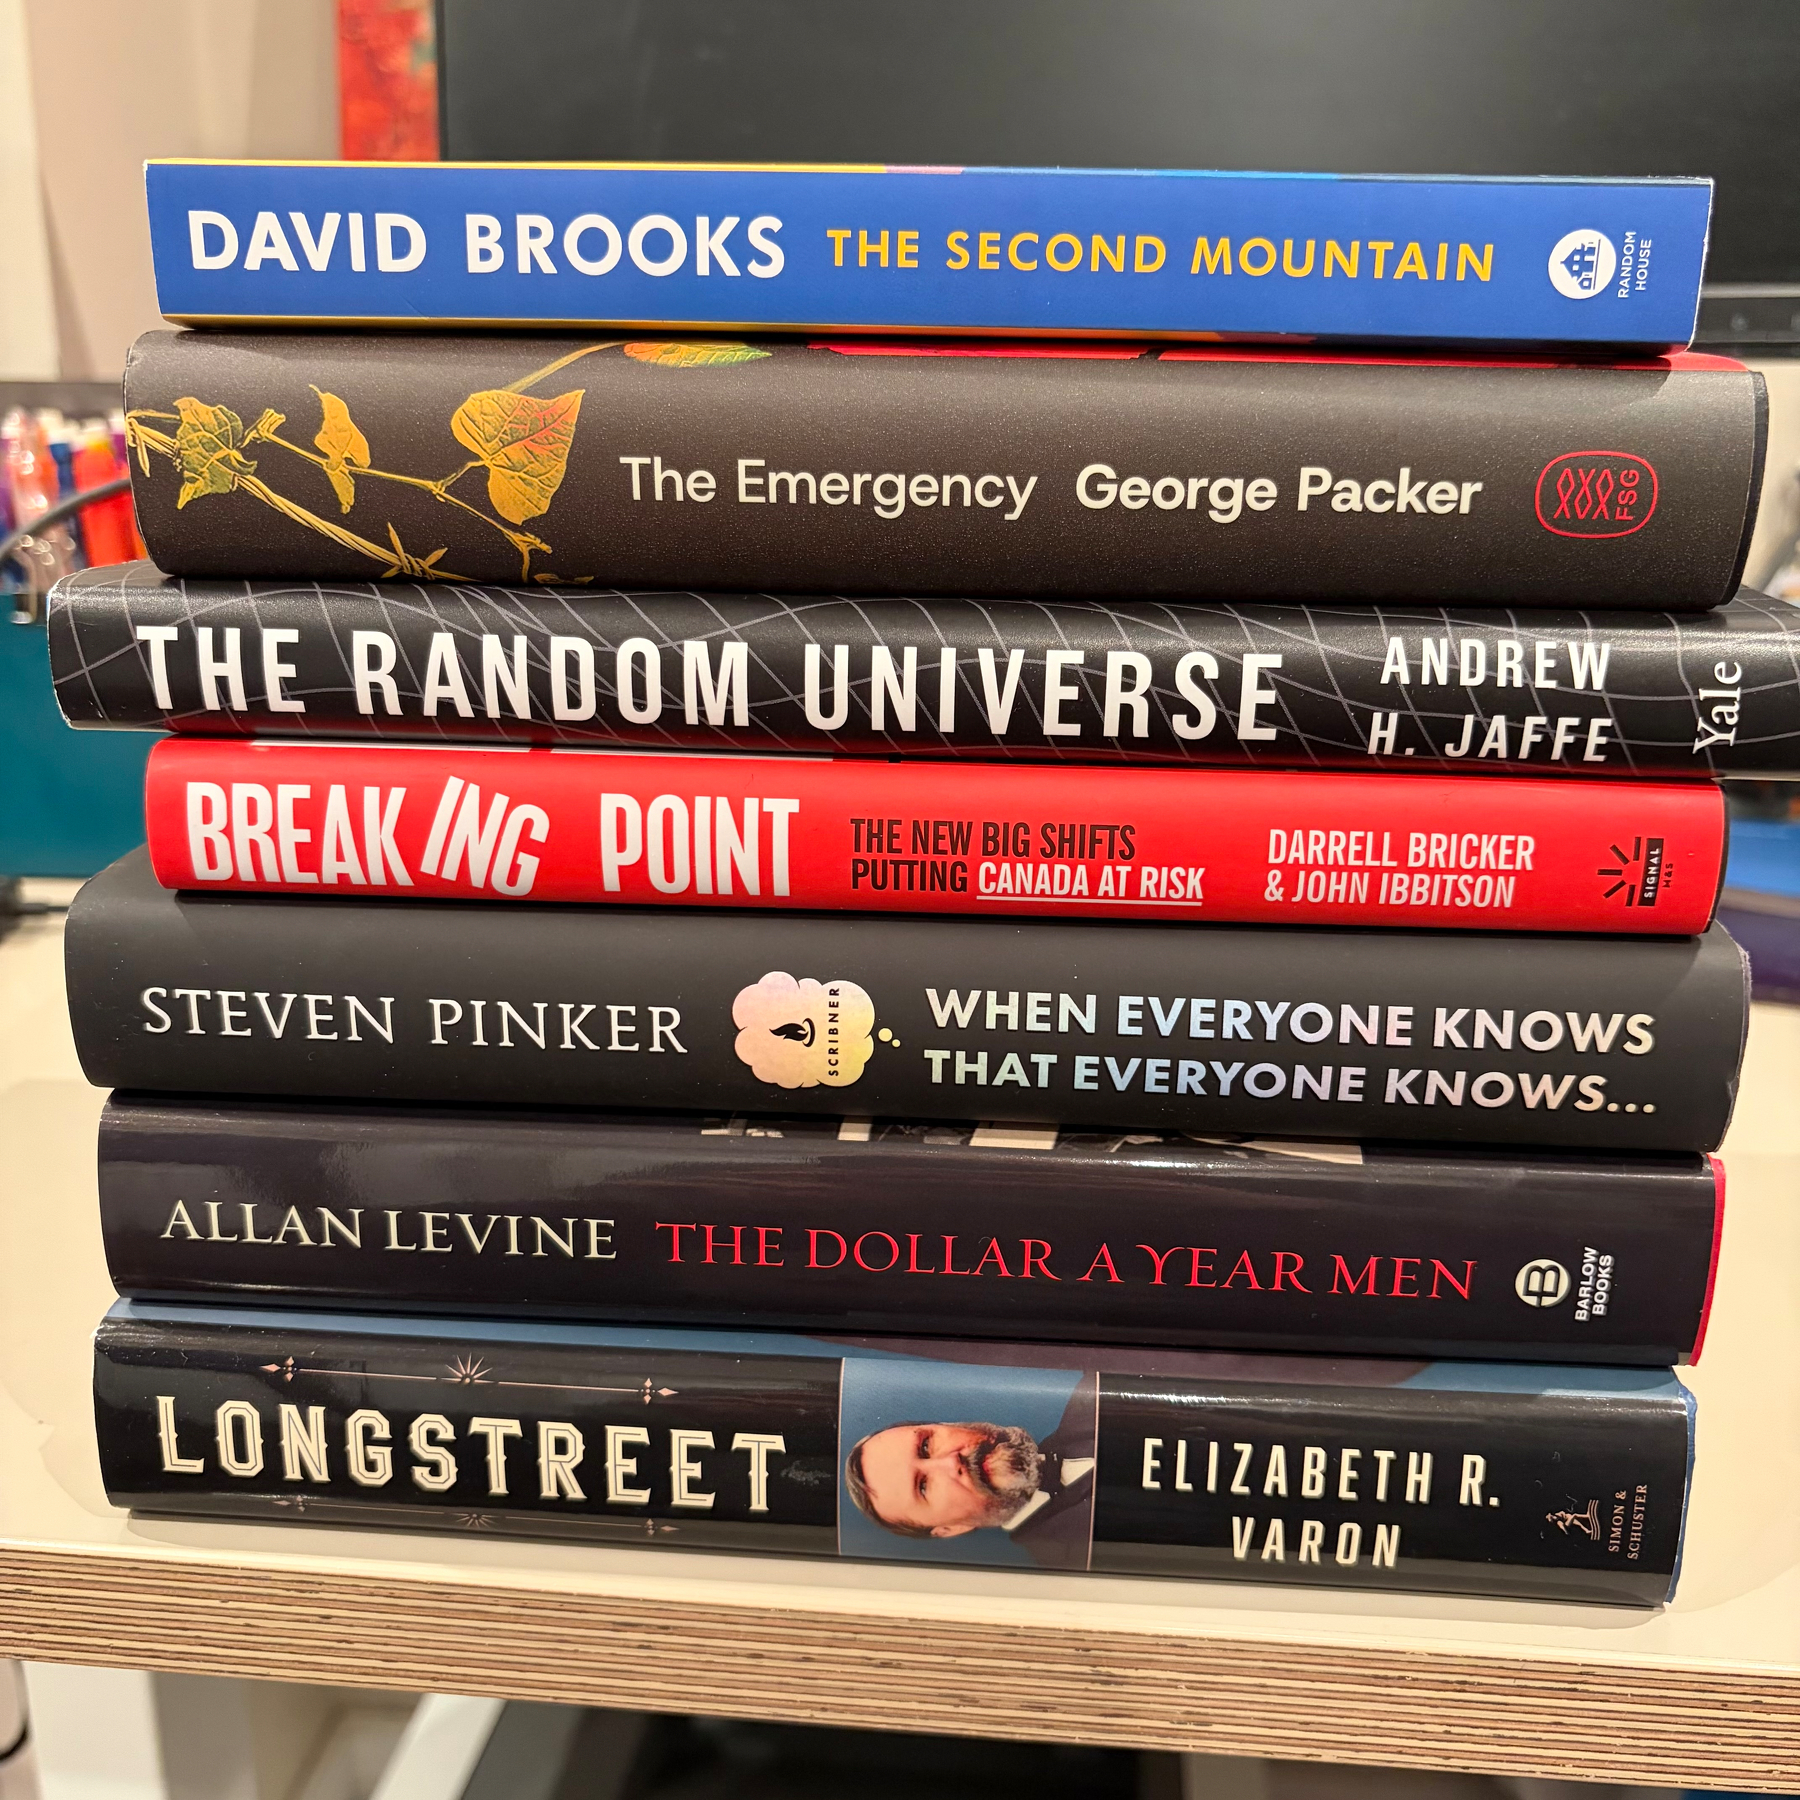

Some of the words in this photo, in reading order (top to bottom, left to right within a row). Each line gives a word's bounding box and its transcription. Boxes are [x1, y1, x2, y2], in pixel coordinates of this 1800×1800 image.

[189, 211, 427, 272] DAVID
[466, 213, 786, 278] BROOKS
[827, 229, 919, 268] THE
[946, 231, 1167, 273] SECOND
[1191, 236, 1494, 282] MOUNTAIN
[1617, 230, 1637, 298] RANDOM
[1634, 239, 1652, 291] HOUSE
[619, 456, 717, 503] The
[737, 458, 1038, 521] Emergency
[1075, 463, 1277, 524] George
[1297, 465, 1483, 515] Packer
[1615, 469, 1640, 521] FSG
[136, 625, 306, 713] THE
[353, 630, 750, 727] RANDOM
[804, 644, 1283, 741] UNIVERSE
[1381, 637, 1612, 692] ANDREW
[1367, 711, 1416, 756] H.
[1445, 713, 1613, 763] JAFFE
[1693, 660, 1743, 755] Yale
[600, 793, 800, 898] POINT
[850, 818, 902, 853] THE
[911, 820, 973, 856] NEW
[981, 822, 1030, 858] BIG
[1039, 824, 1136, 861] SHIFTS
[1268, 829, 1400, 870] DARRELL
[1406, 834, 1535, 872] BRICKER
[851, 859, 968, 892] PUTTING
[977, 861, 1089, 896] CANADA
[1097, 865, 1132, 897] AT
[1138, 866, 1206, 899] RISK
[1264, 869, 1286, 904] &
[1292, 872, 1369, 906] JOHN
[1376, 875, 1516, 909] IBBITSON
[1643, 848, 1661, 898] SIGNAL
[142, 987, 397, 1045] STEVEN
[429, 997, 689, 1055] PINKER
[828, 988, 840, 1076] SCRIBNER
[925, 988, 1097, 1035] WHEN
[1116, 995, 1413, 1048] EVERYONE
[1432, 1006, 1657, 1056] KNOWS
[924, 1049, 1057, 1087] THAT
[1072, 1052, 1365, 1103] EVERYONE
[1385, 1068, 1658, 1115] KNOWS...
[160, 1199, 364, 1250] ALLAN
[382, 1208, 619, 1262] LEVINE
[655, 1220, 785, 1267] THE
[804, 1227, 1062, 1284] DOLLAR
[1078, 1242, 1123, 1285] A
[1135, 1243, 1314, 1295] YEAR
[1327, 1255, 1479, 1302] MEN
[1574, 1246, 1599, 1321] BARLOW
[1592, 1254, 1615, 1316] BOOKS
[153, 1395, 788, 1513] LONGSTREET
[1140, 1437, 1433, 1505] ELIZABETH
[1459, 1453, 1501, 1507] R.
[1614, 1490, 1627, 1500] &
[1626, 1484, 1648, 1560] SCHUSTER
[1230, 1515, 1401, 1569] VARON
[1607, 1505, 1625, 1553] SIMON
